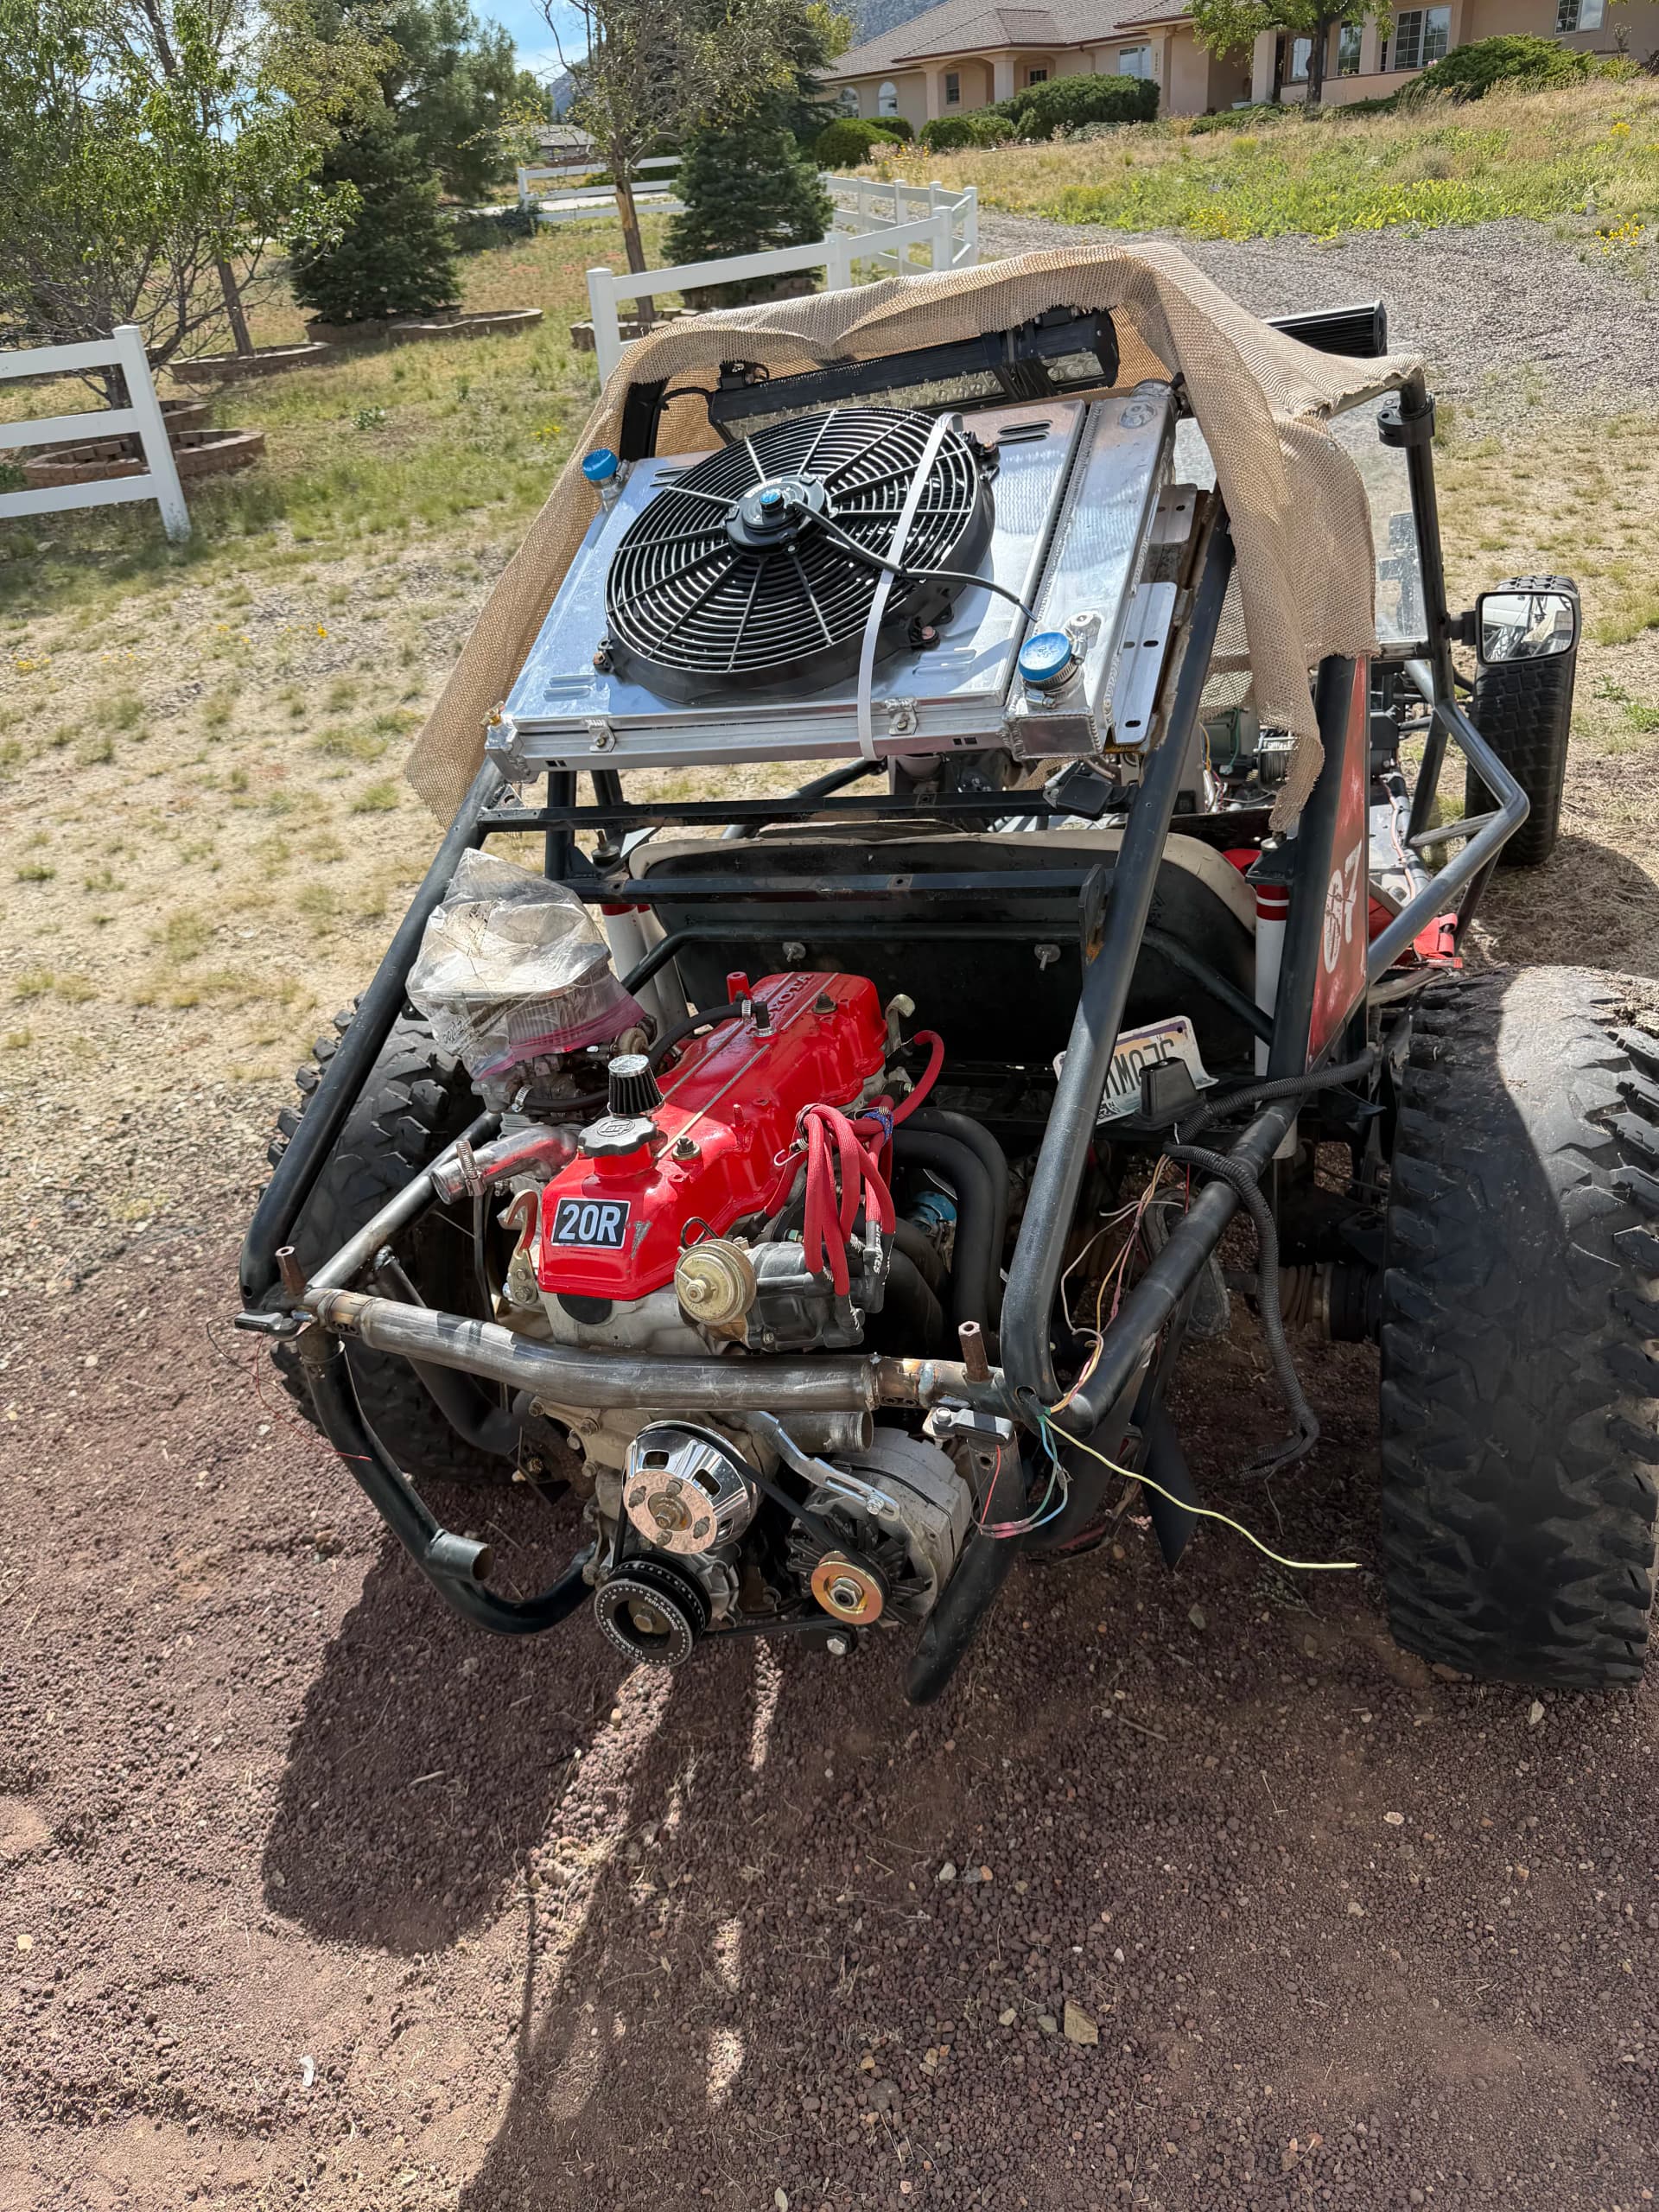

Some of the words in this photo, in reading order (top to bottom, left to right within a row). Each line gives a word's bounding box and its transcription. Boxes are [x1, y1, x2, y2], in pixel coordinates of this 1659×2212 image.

[746, 974, 814, 1034] TYOTA
[558, 1204, 620, 1243] 20R
[644, 1595, 679, 1630] PERFORMANCE
